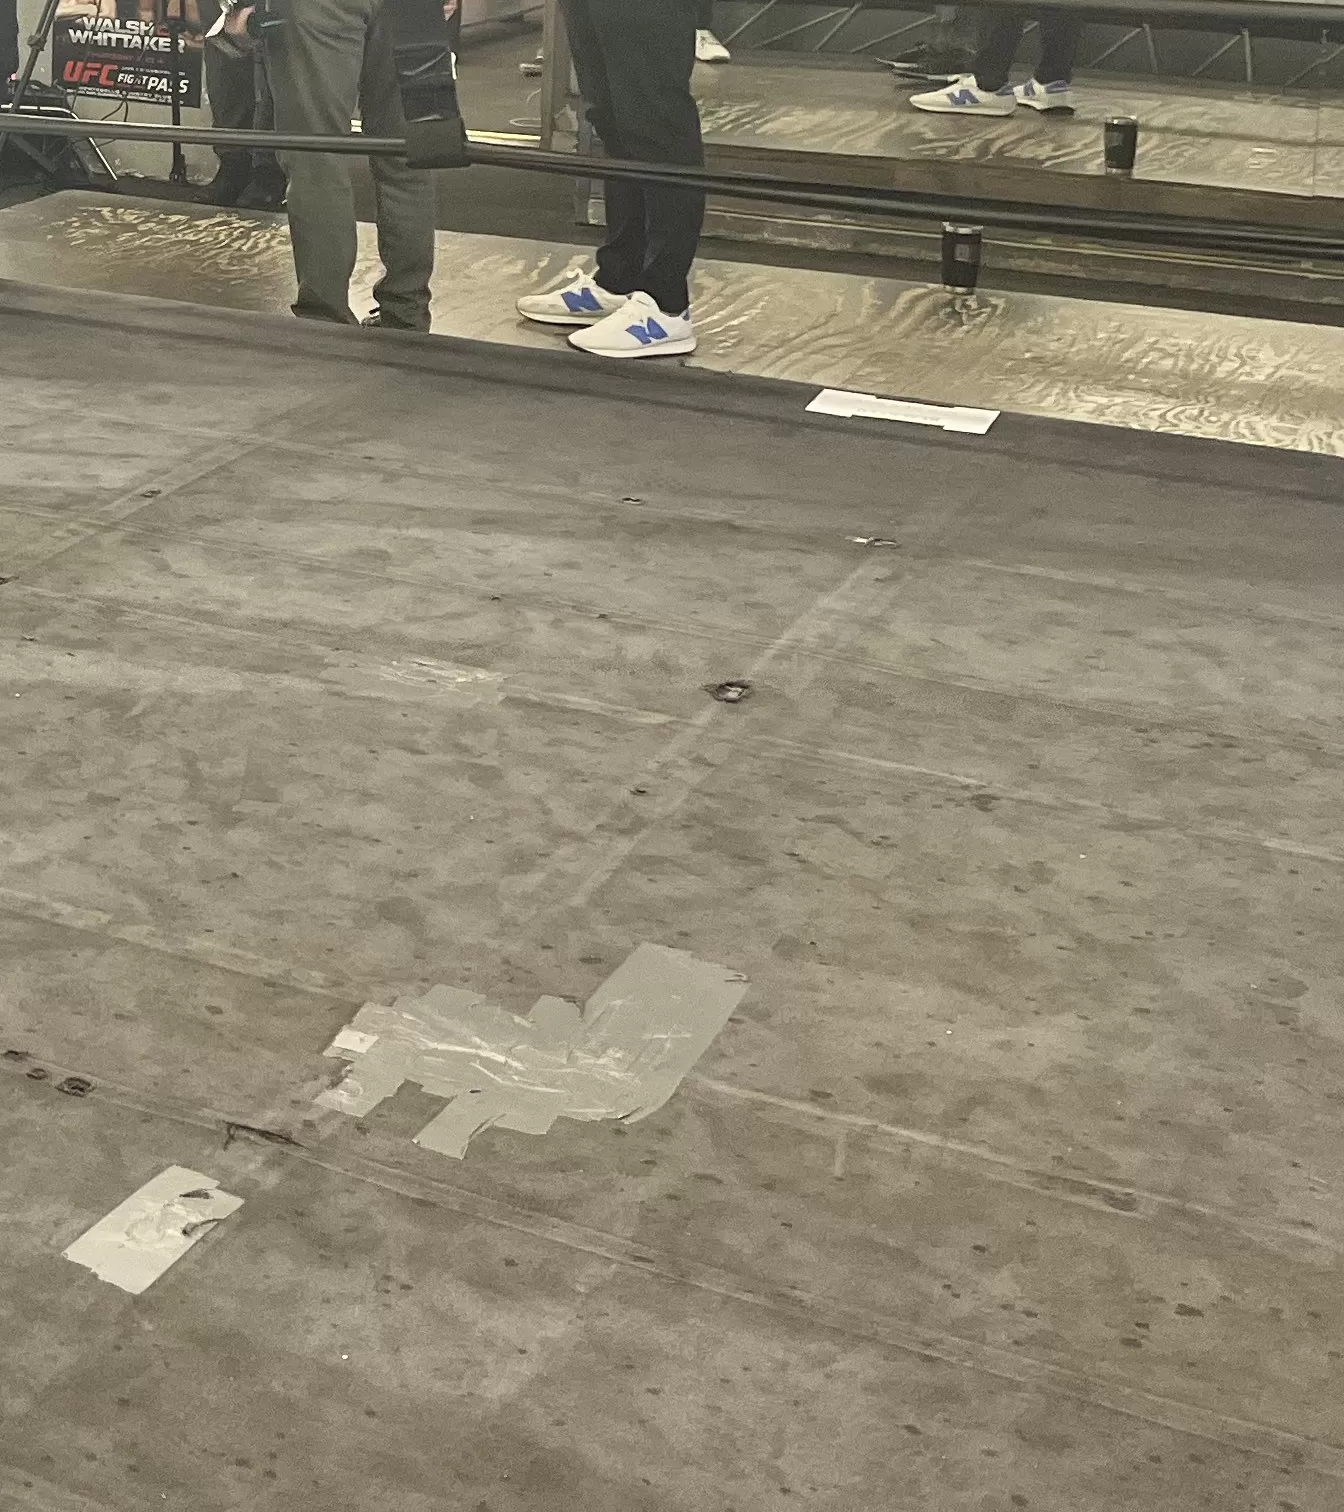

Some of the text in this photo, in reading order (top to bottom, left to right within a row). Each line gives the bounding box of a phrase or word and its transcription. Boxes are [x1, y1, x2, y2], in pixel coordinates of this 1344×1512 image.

[82, 16, 155, 36] WALSH
[63, 60, 119, 87] UFC
[148, 76, 190, 94] PAS
